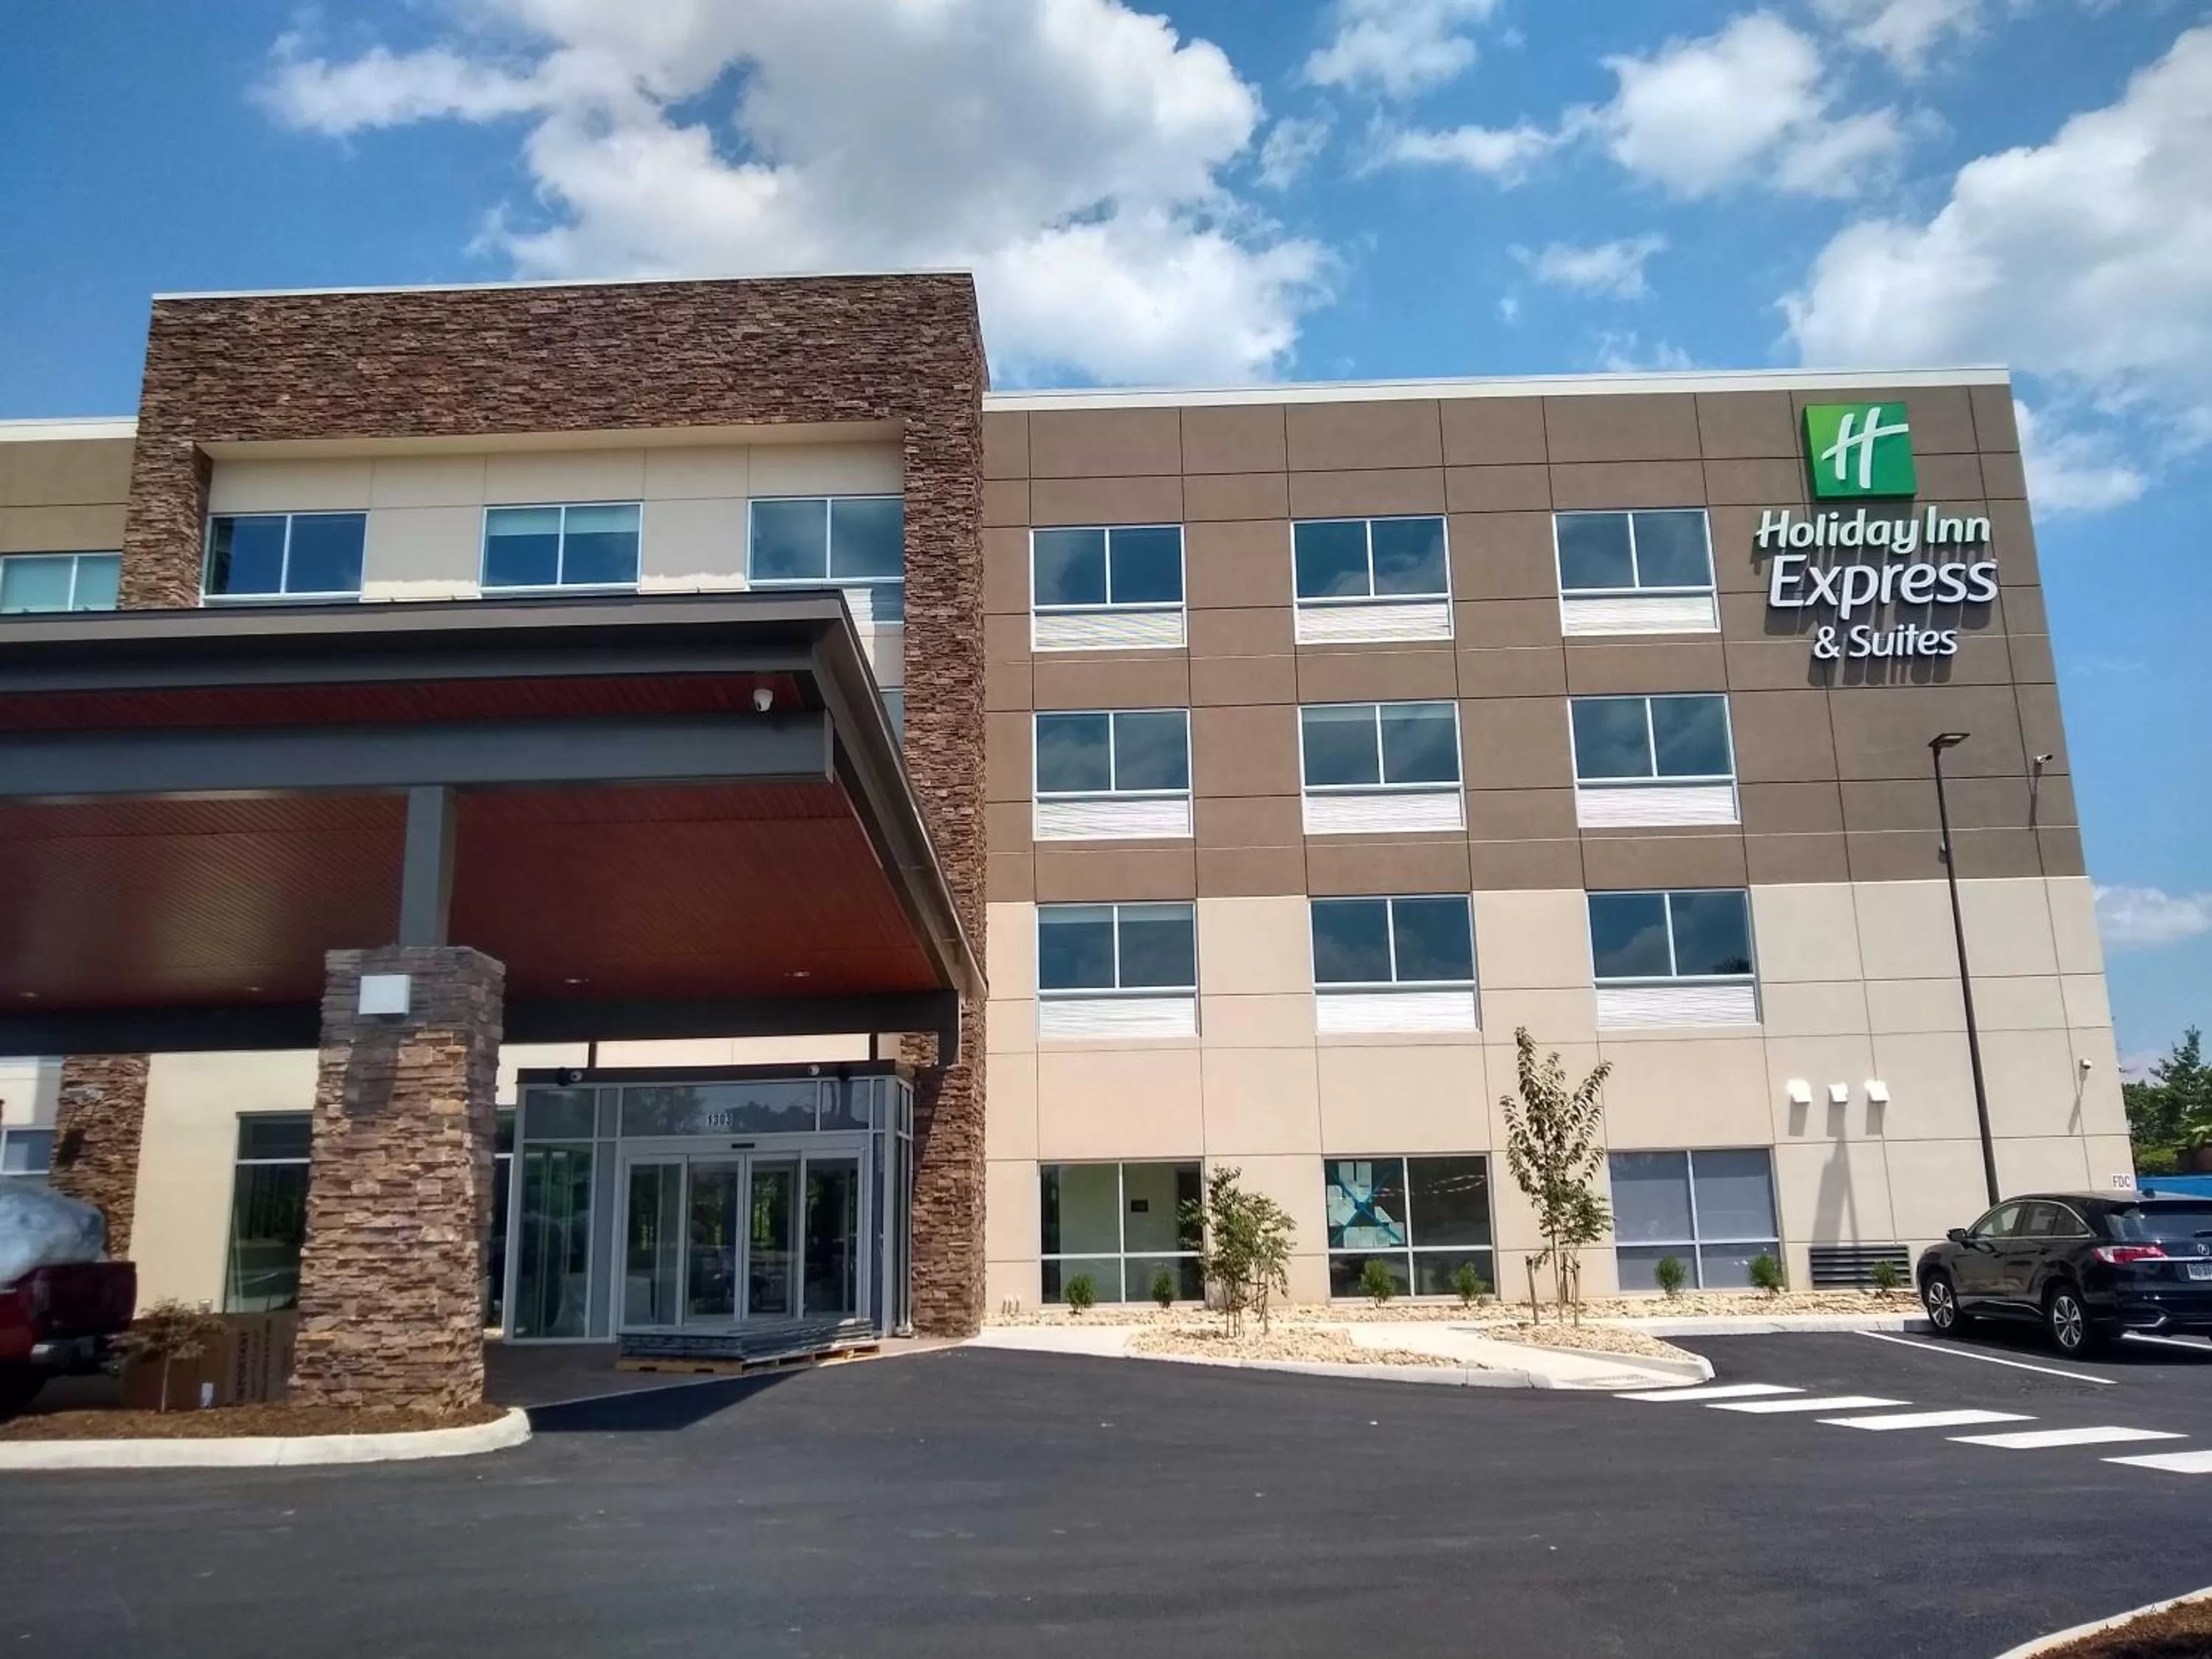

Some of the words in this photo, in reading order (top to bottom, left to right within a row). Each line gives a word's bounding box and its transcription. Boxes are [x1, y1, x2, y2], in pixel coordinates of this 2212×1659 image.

[1755, 509, 1919, 554] Holiday
[1926, 506, 1990, 544] Inn
[1770, 554, 1999, 620] Express
[1813, 625, 1840, 658] &
[1849, 623, 1958, 658] Suites
[708, 1114, 731, 1125] 1303
[2112, 1175, 2131, 1188] FDC
